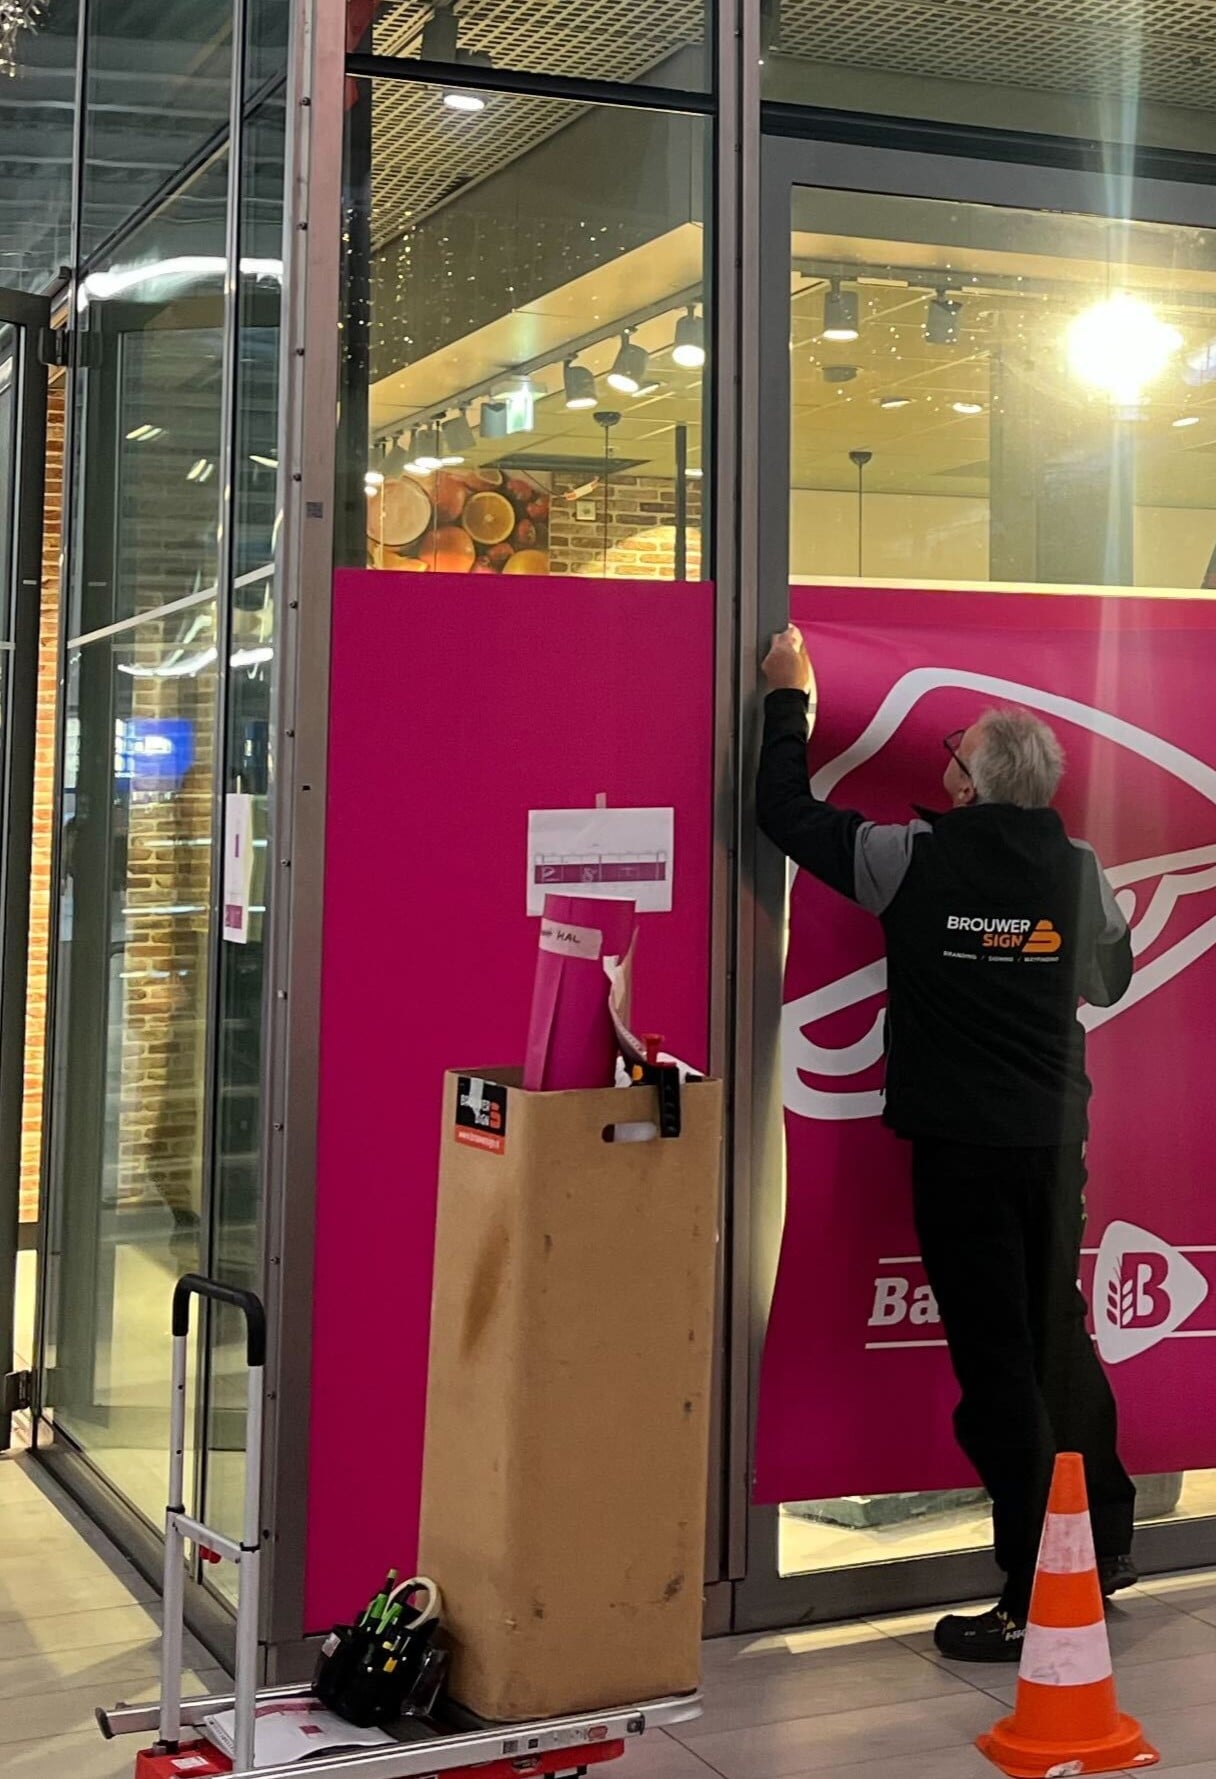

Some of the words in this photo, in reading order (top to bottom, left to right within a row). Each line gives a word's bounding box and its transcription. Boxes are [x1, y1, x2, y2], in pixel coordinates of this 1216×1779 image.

[946, 915, 1031, 933] BROUWER
[981, 933, 1024, 948] SIGN
[867, 1277, 942, 1327] Ba
